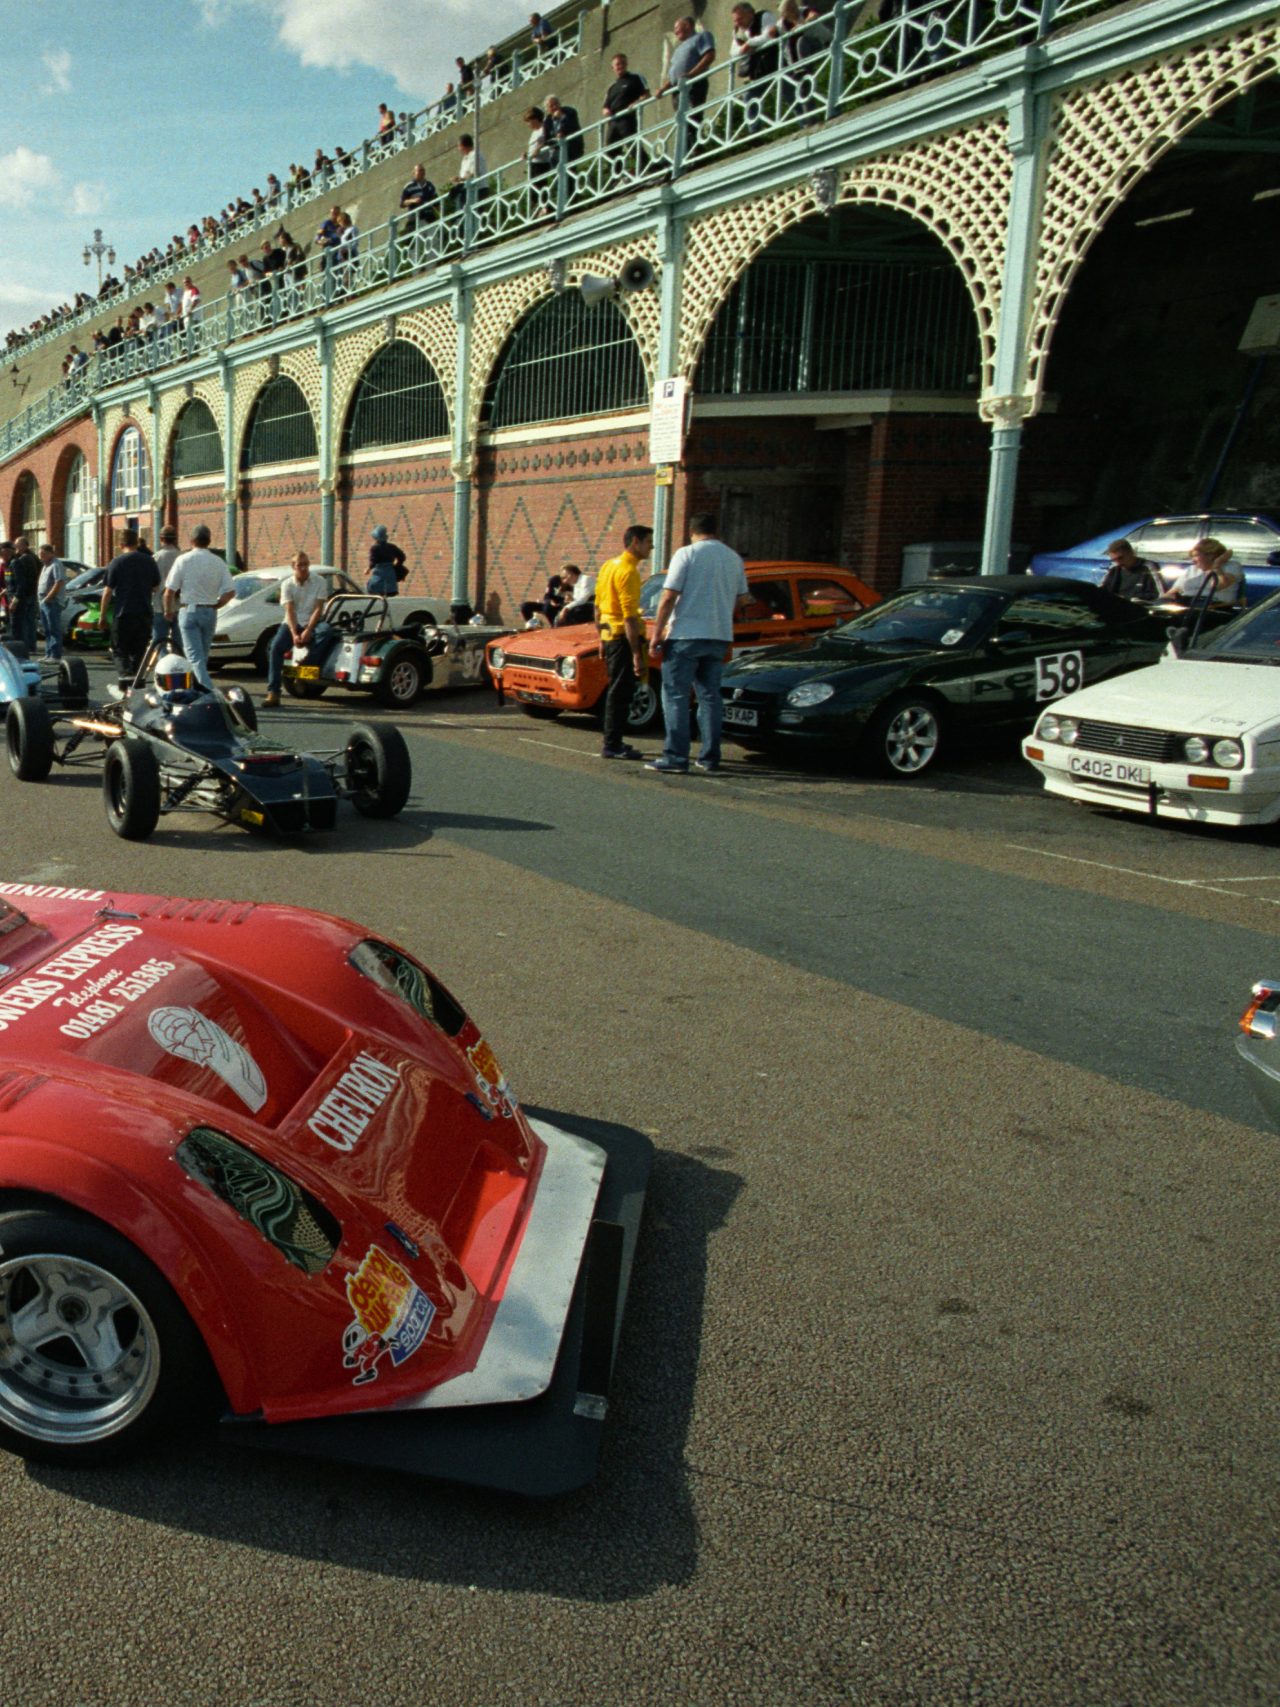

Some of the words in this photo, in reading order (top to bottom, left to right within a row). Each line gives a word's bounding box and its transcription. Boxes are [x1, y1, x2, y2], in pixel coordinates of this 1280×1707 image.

[1039, 655, 1081, 698] 58
[1071, 758, 1113, 777] C402
[1116, 765, 1150, 784] DKL
[35, 923, 144, 981] EXPRESS
[52, 967, 124, 1009] Telephone
[59, 999, 126, 1039] 01481
[108, 957, 177, 1002] 251385
[307, 1050, 401, 1152] CHEVRON
[399, 1294, 430, 1348] sparco
